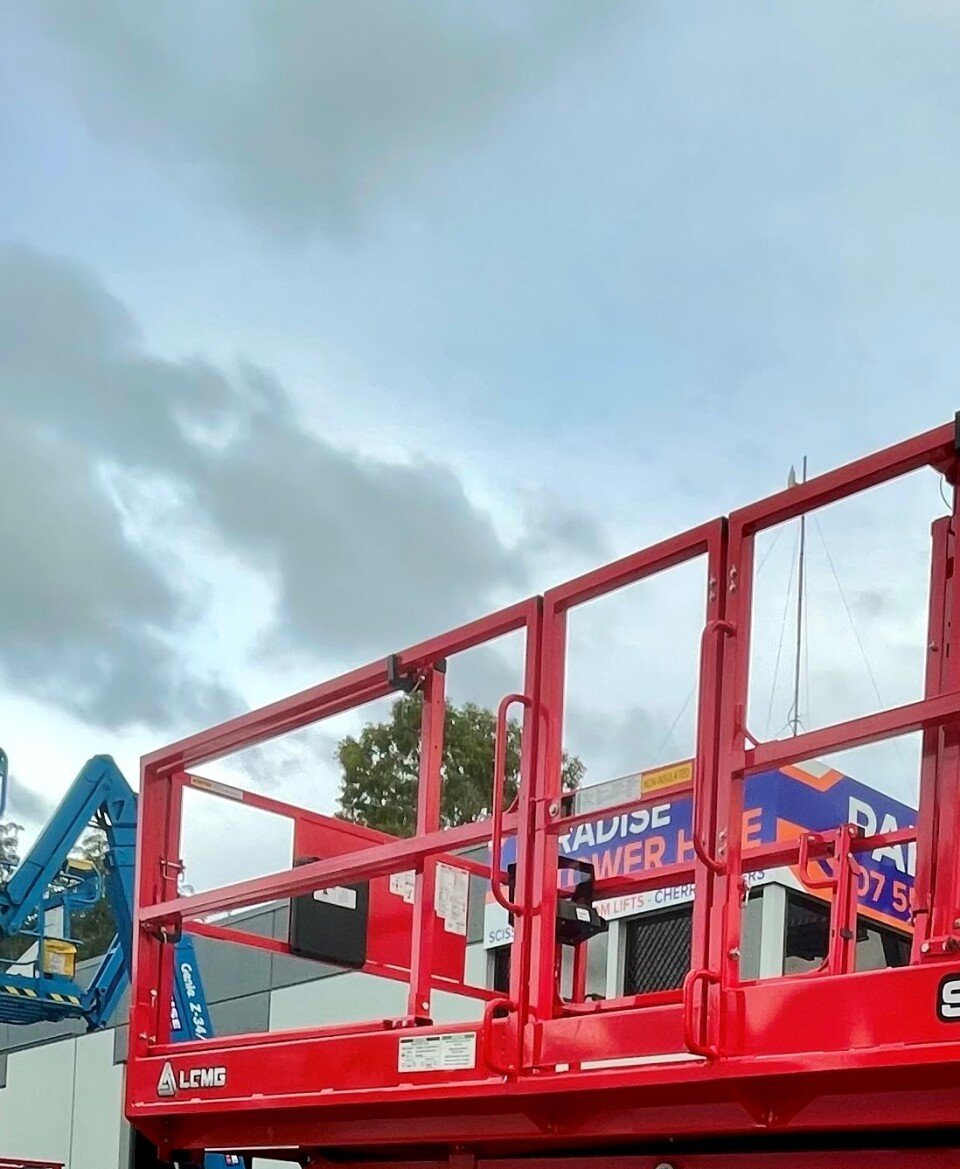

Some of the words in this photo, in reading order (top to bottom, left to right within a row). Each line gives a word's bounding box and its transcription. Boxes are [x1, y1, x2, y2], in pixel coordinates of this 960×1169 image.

[613, 894, 645, 913] LIFTS
[489, 927, 515, 943] SCIS
[189, 1002, 207, 1040] Z-34/
